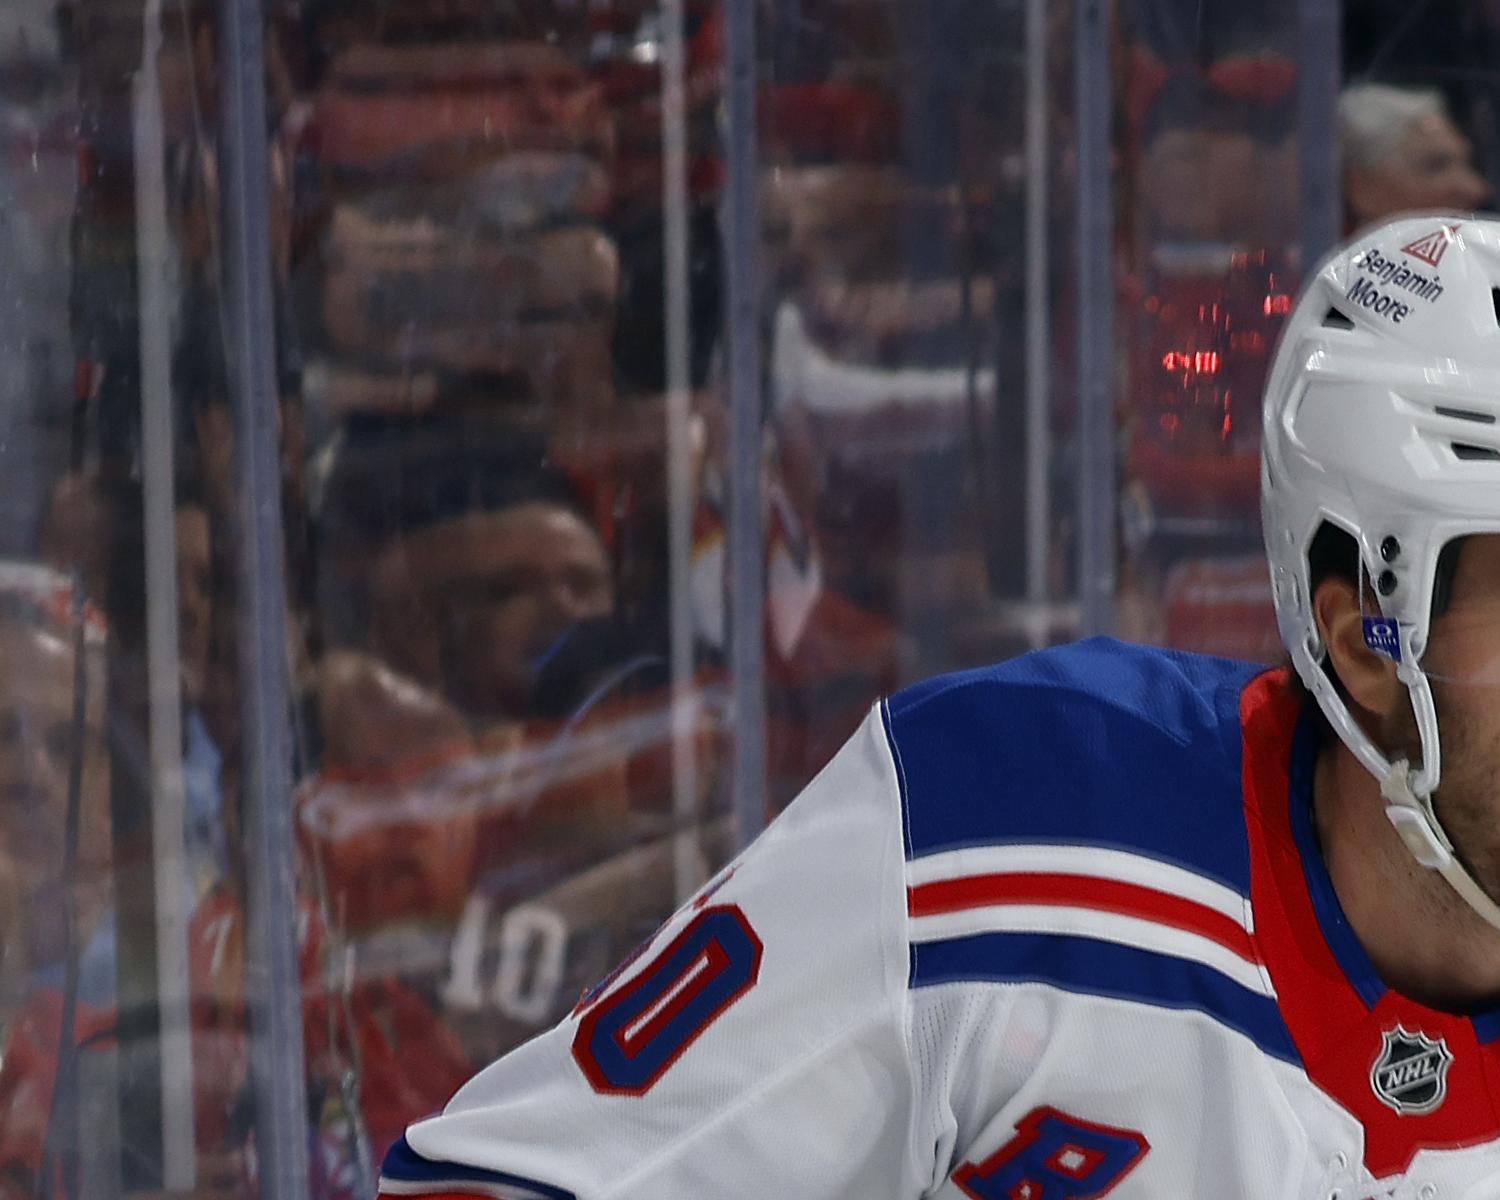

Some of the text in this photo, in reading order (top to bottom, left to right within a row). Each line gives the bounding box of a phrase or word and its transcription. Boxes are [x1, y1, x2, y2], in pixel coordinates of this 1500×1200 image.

[1345, 277, 1409, 323] Moore
[1357, 249, 1444, 303] Benjamin
[571, 863, 765, 1098] 0
[1384, 1057, 1436, 1090] NHL
